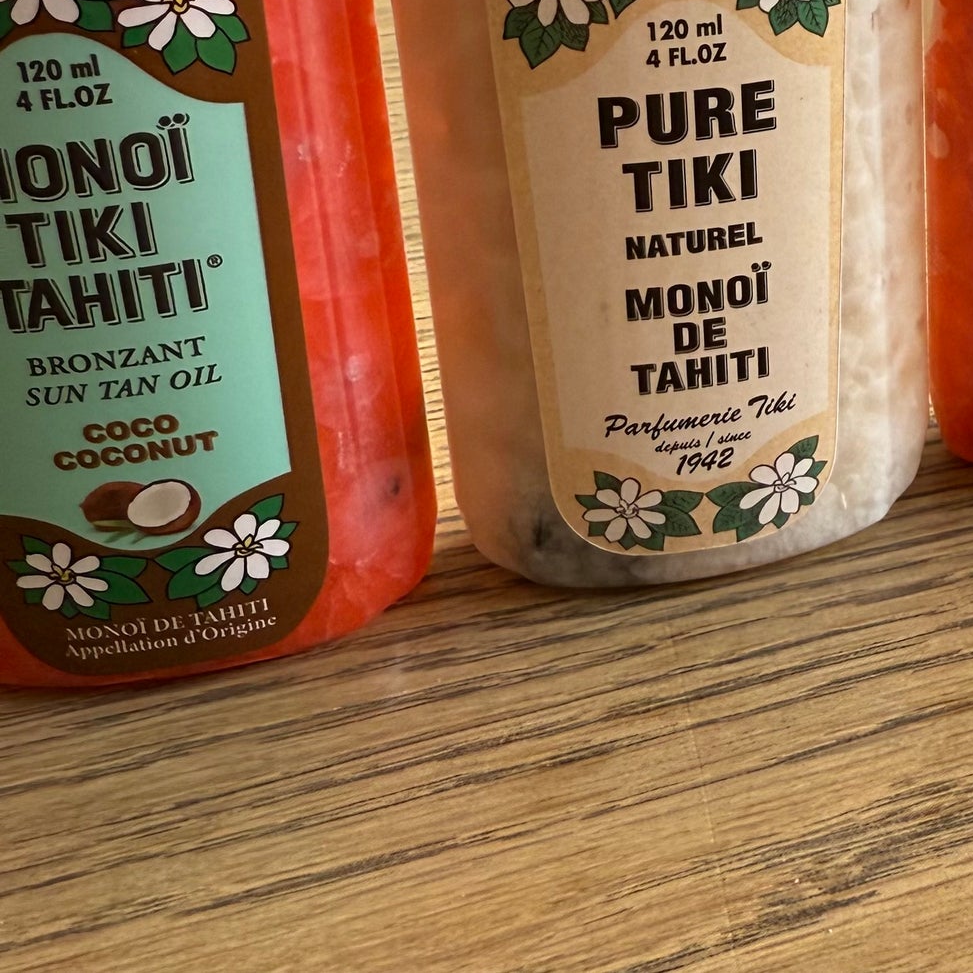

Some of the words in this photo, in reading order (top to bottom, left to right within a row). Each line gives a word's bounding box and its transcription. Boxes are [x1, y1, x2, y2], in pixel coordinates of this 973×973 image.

[647, 19, 688, 41] 120
[696, 13, 723, 37] ml
[17, 60, 63, 83] 120
[71, 54, 101, 79] ml
[646, 49, 660, 68] 4
[669, 43, 727, 66] FL.OZ
[16, 91, 33, 112] 4
[41, 83, 113, 110] FL.OZ
[597, 79, 777, 149] PURE
[622, 149, 758, 213] TIKI
[4, 202, 158, 267] TIKI
[625, 222, 763, 260] NATUREL
[625, 261, 772, 321] MONOÏ
[673, 317, 727, 355] DE
[27, 336, 206, 378] BRONZANT
[630, 346, 770, 395] TAHITI
[25, 383, 89, 407] SUN
[99, 372, 165, 400] TAN
[170, 363, 223, 390] OIL
[82, 414, 179, 444] COCO
[604, 407, 742, 441] Parfumerie
[748, 391, 797, 419] Tiki
[53, 430, 219, 471] COCONUT
[655, 439, 701, 455] depuis
[718, 430, 751, 445] since
[676, 447, 735, 476] 1942
[66, 618, 147, 642] MONOÏ
[153, 614, 186, 633] DE
[188, 598, 269, 625] TAHITI
[66, 636, 178, 660] Appellation
[184, 615, 277, 645] d'Origine
